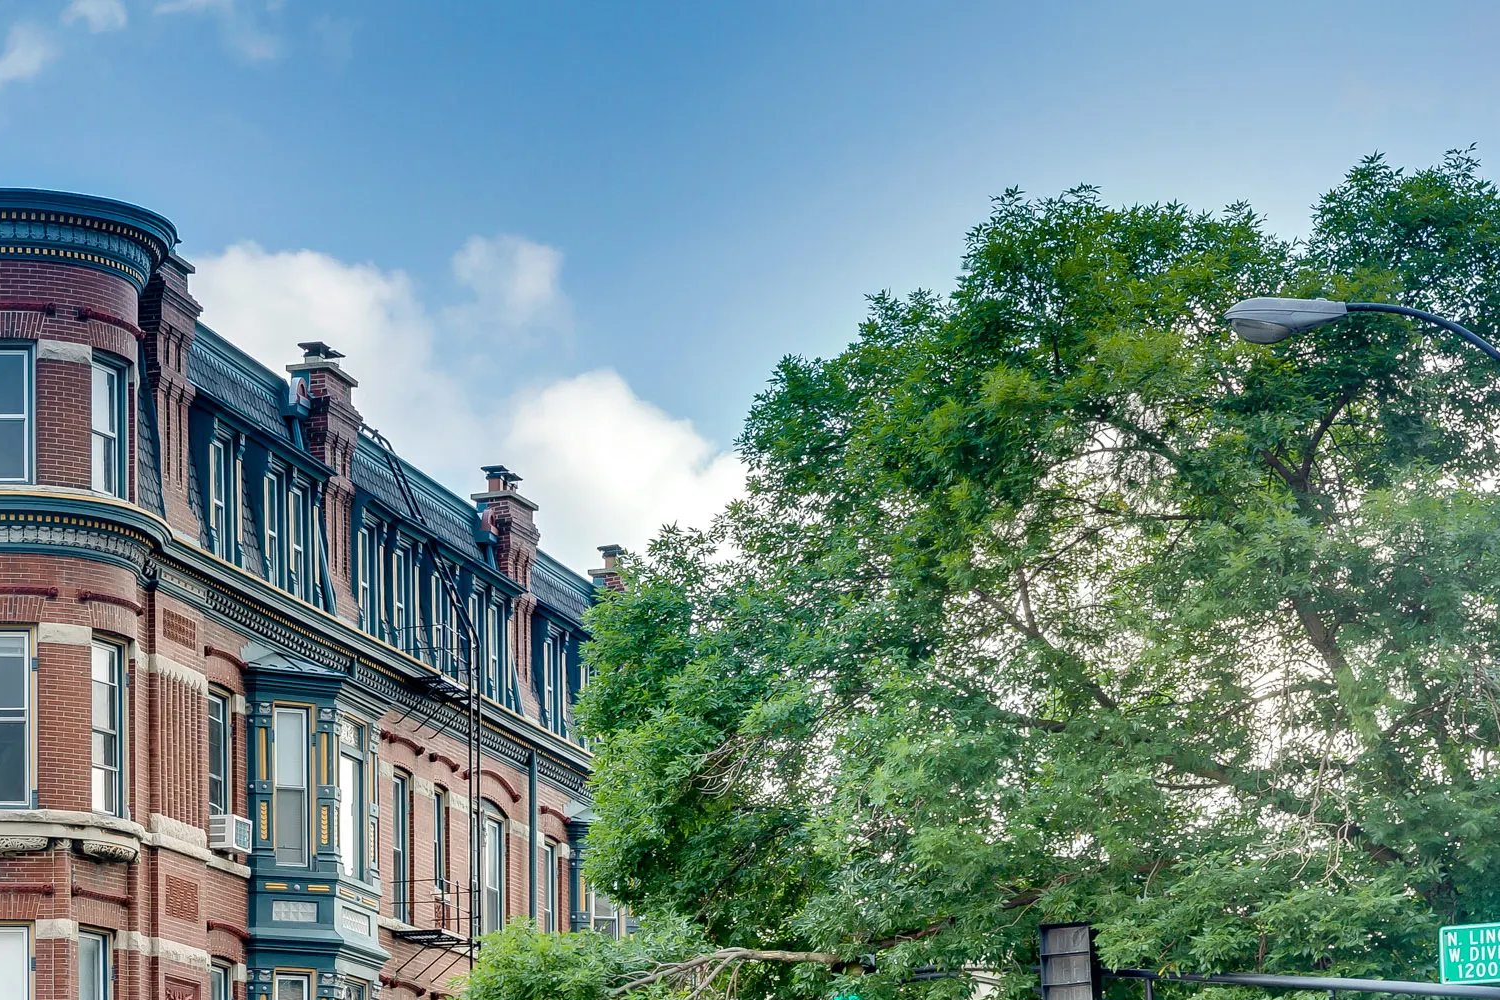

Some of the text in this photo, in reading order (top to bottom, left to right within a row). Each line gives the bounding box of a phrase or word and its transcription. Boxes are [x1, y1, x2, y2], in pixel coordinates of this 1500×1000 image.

[1447, 928, 1500, 946] N. LIN
[1449, 948, 1464, 963] W.
[1457, 961, 1498, 979] 1200
